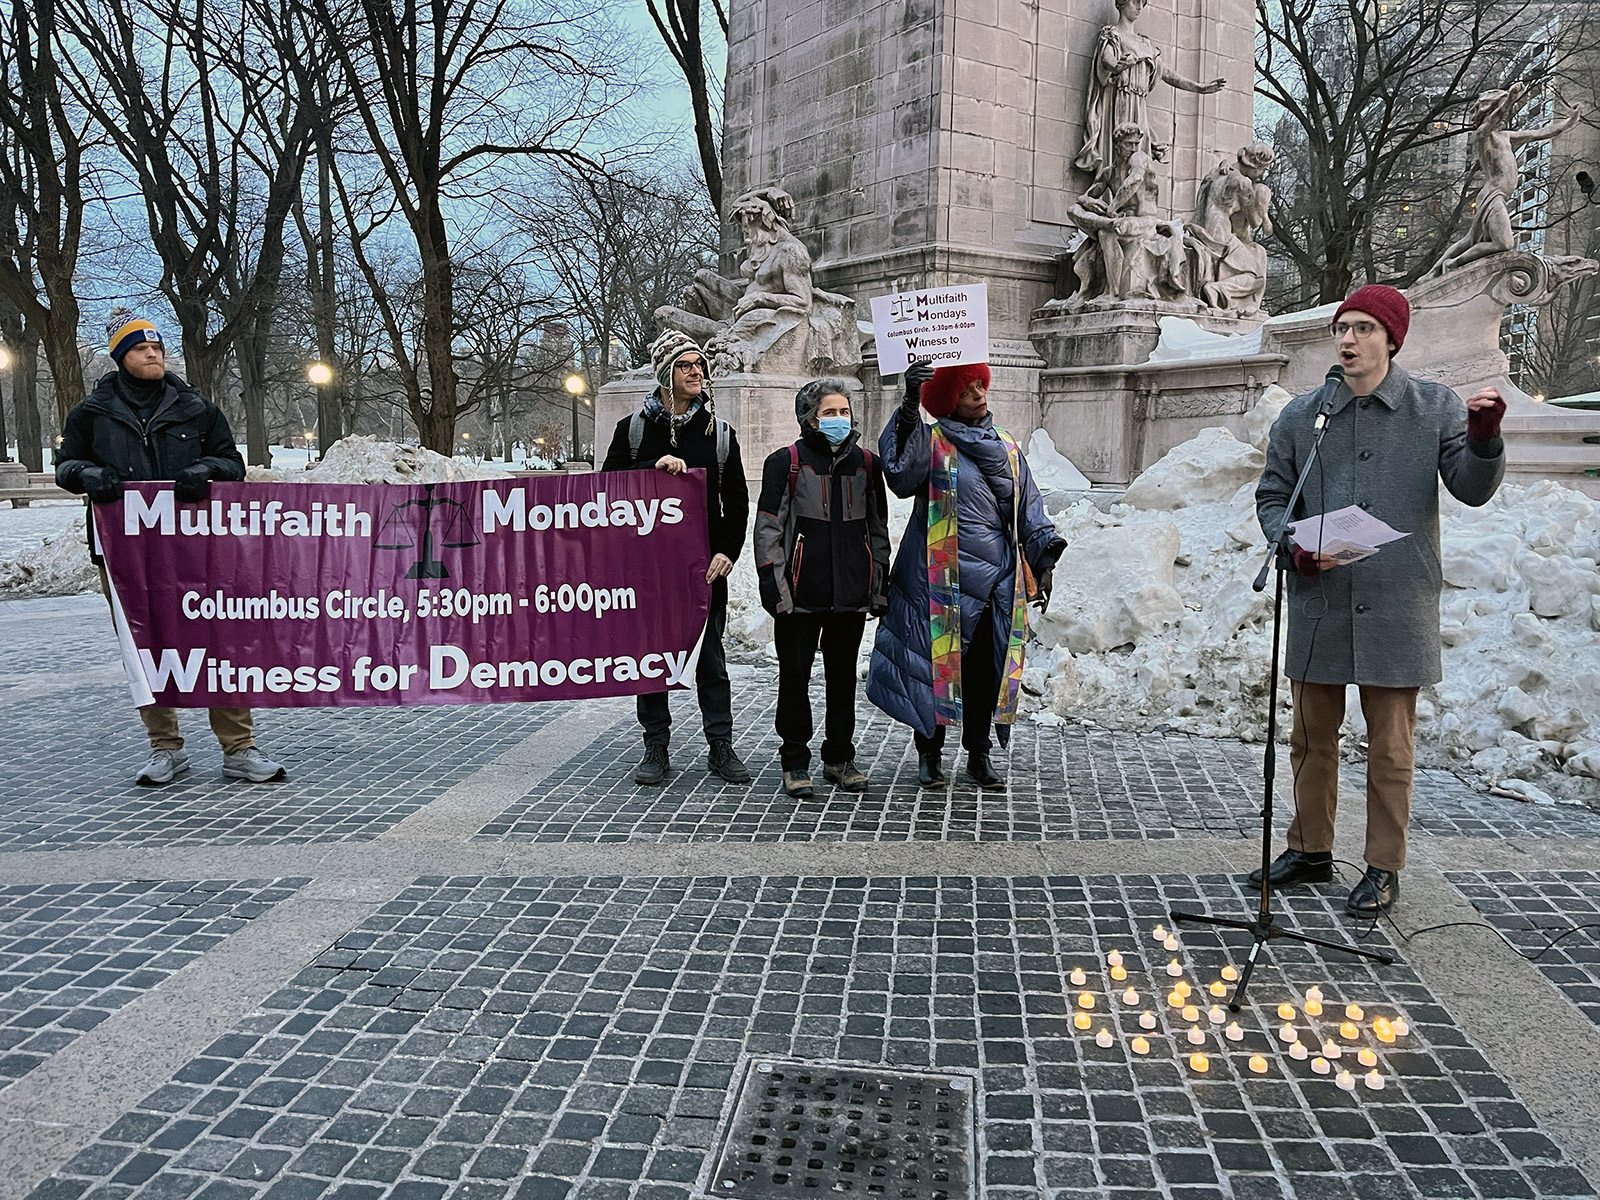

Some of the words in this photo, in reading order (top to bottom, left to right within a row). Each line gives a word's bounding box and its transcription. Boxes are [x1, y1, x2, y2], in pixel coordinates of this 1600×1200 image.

[916, 293, 968, 307] Multifaith
[917, 309, 967, 322] Mondays
[887, 329, 913, 338] Columbus
[905, 337, 947, 349] Witness
[950, 336, 960, 344] to
[907, 350, 962, 364] Democracy
[124, 490, 372, 537] Multifaith
[482, 487, 684, 536] Mondays
[182, 589, 320, 620] Columbus
[325, 589, 410, 623] Circle,
[417, 588, 512, 623] 5:30pm
[519, 598, 528, 607] -
[534, 583, 637, 619] 6:00pm
[137, 648, 341, 693] Witness
[352, 656, 417, 692] for
[429, 645, 688, 690] Democracy
